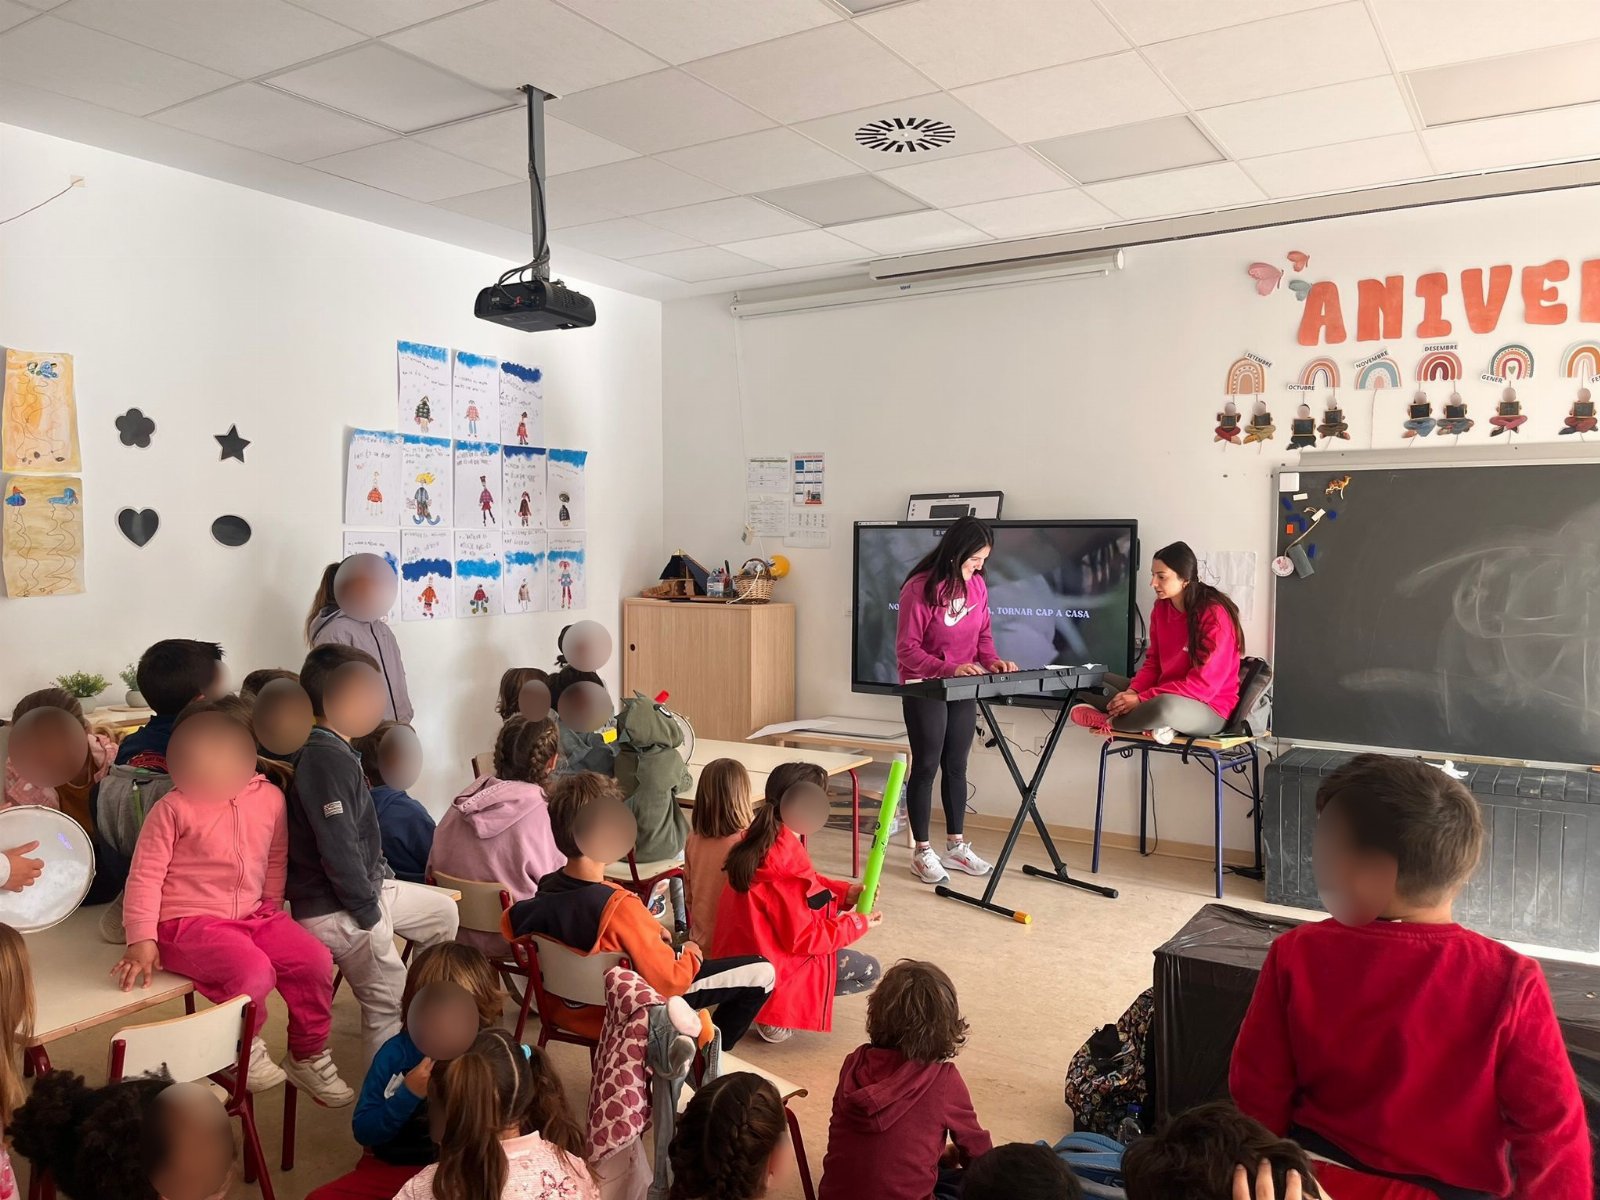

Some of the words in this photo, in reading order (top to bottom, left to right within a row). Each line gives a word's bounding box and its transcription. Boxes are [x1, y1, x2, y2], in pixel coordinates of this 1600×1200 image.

[1424, 344, 1459, 352] DESEMBRE
[1246, 352, 1273, 369] SETEMBRE
[1355, 350, 1390, 369] NOVEMBRE
[1481, 374, 1504, 384] GENER
[1591, 375, 1600, 384] FE
[996, 607, 1034, 617] TORNAR
[1035, 608, 1054, 617] CAP
[1055, 609, 1063, 618] A
[1065, 609, 1090, 619] CASA
